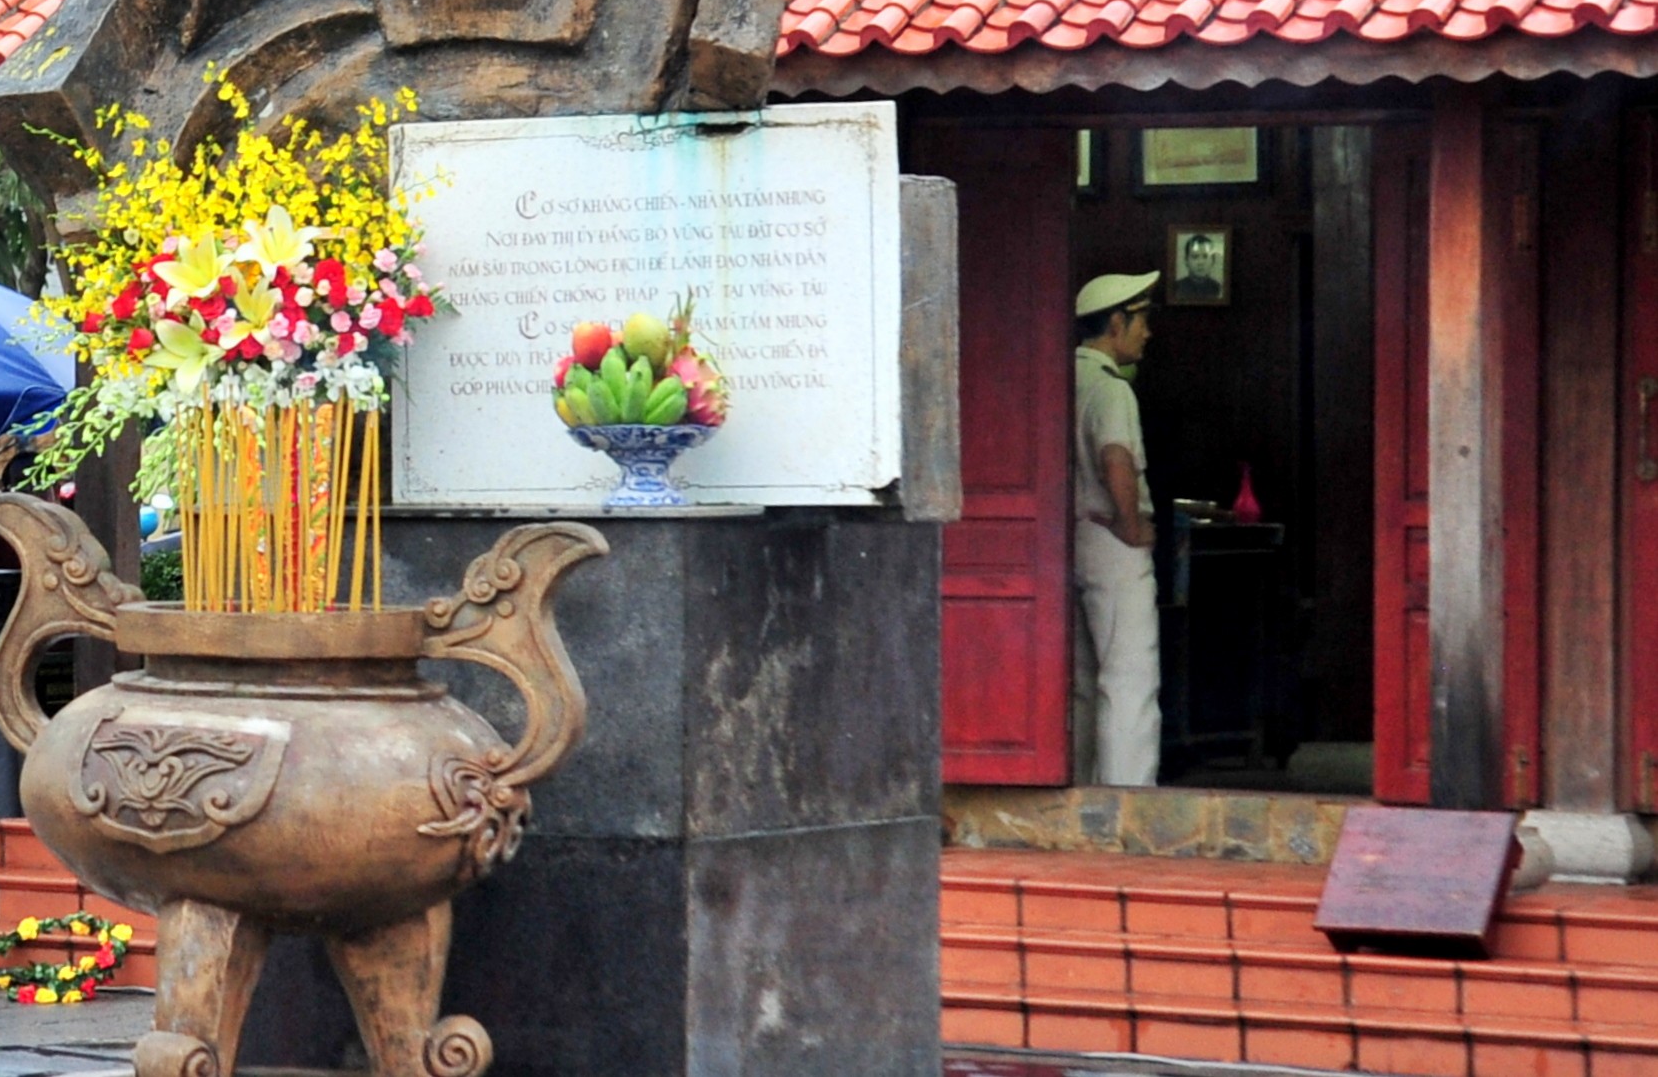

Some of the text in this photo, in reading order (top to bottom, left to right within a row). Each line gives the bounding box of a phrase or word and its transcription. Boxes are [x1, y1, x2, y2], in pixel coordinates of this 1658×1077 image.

[583, 194, 631, 213] KHÁNG
[776, 189, 826, 206] NHUNG
[510, 260, 561, 275] TRONG
[449, 286, 500, 306] KHÁNG
[775, 314, 828, 329] NHUNG
[495, 351, 522, 366] DUY
